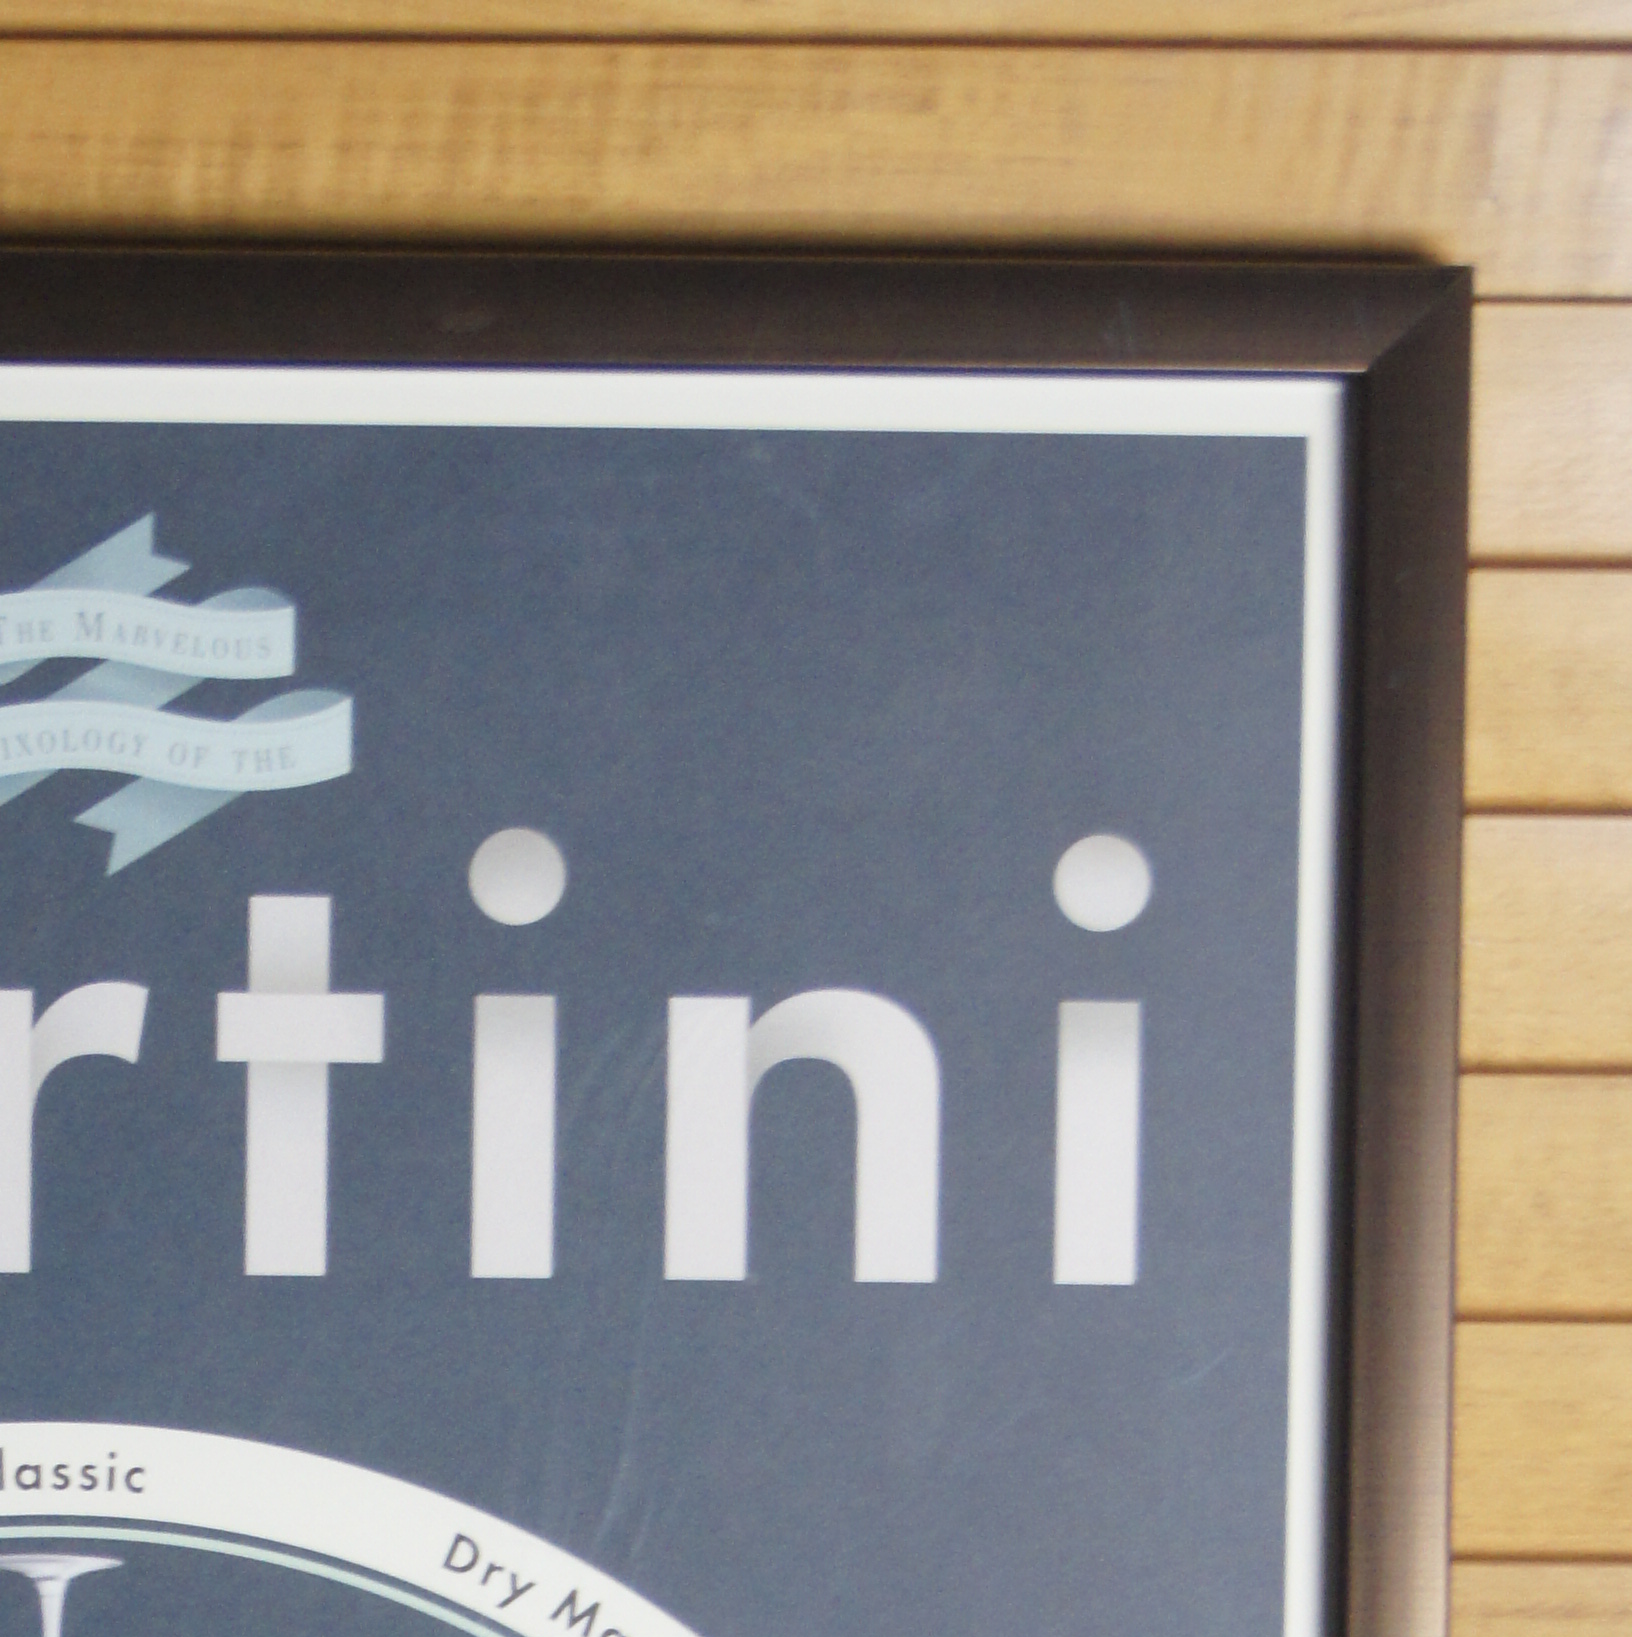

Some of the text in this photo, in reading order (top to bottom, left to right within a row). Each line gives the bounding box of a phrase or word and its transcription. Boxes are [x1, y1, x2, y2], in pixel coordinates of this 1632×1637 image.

[170, 741, 210, 769] OF
[231, 746, 296, 773] THE
[442, 1532, 537, 1608] Dry
